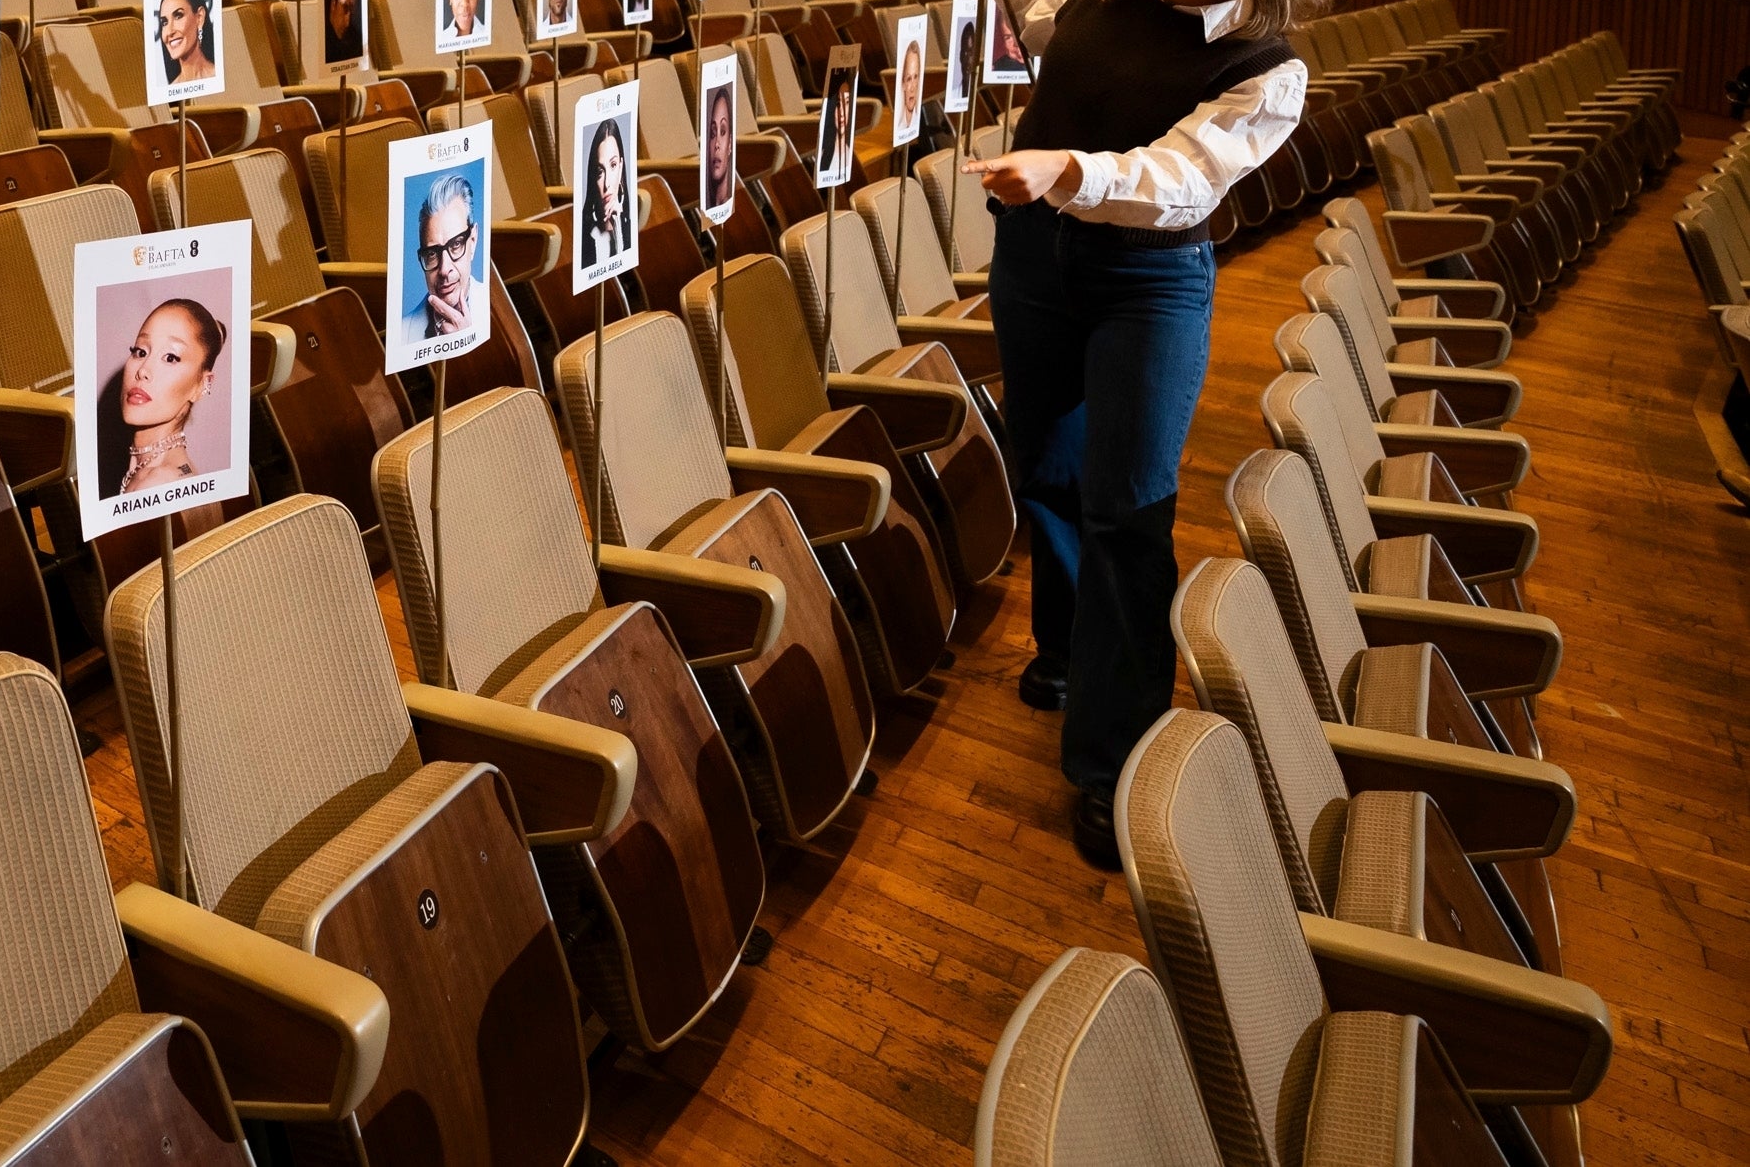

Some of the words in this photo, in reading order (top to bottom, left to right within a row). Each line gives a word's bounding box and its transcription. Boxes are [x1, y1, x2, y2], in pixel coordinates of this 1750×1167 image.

[168, 88, 182, 97] DEMI
[183, 84, 205, 95] MOORE
[437, 145, 461, 158] BAFTA
[6, 180, 17, 191] 21
[148, 248, 185, 264] BAFTA
[588, 266, 607, 281] MARISA
[608, 259, 623, 272] ABELA
[308, 336, 318, 348] 21
[414, 347, 433, 361] JEFF
[434, 333, 477, 354] GOLDBLUM
[112, 495, 161, 516] ARIANA
[164, 480, 216, 502] GRANDE
[610, 694, 624, 716] 20
[420, 896, 436, 924] 19
